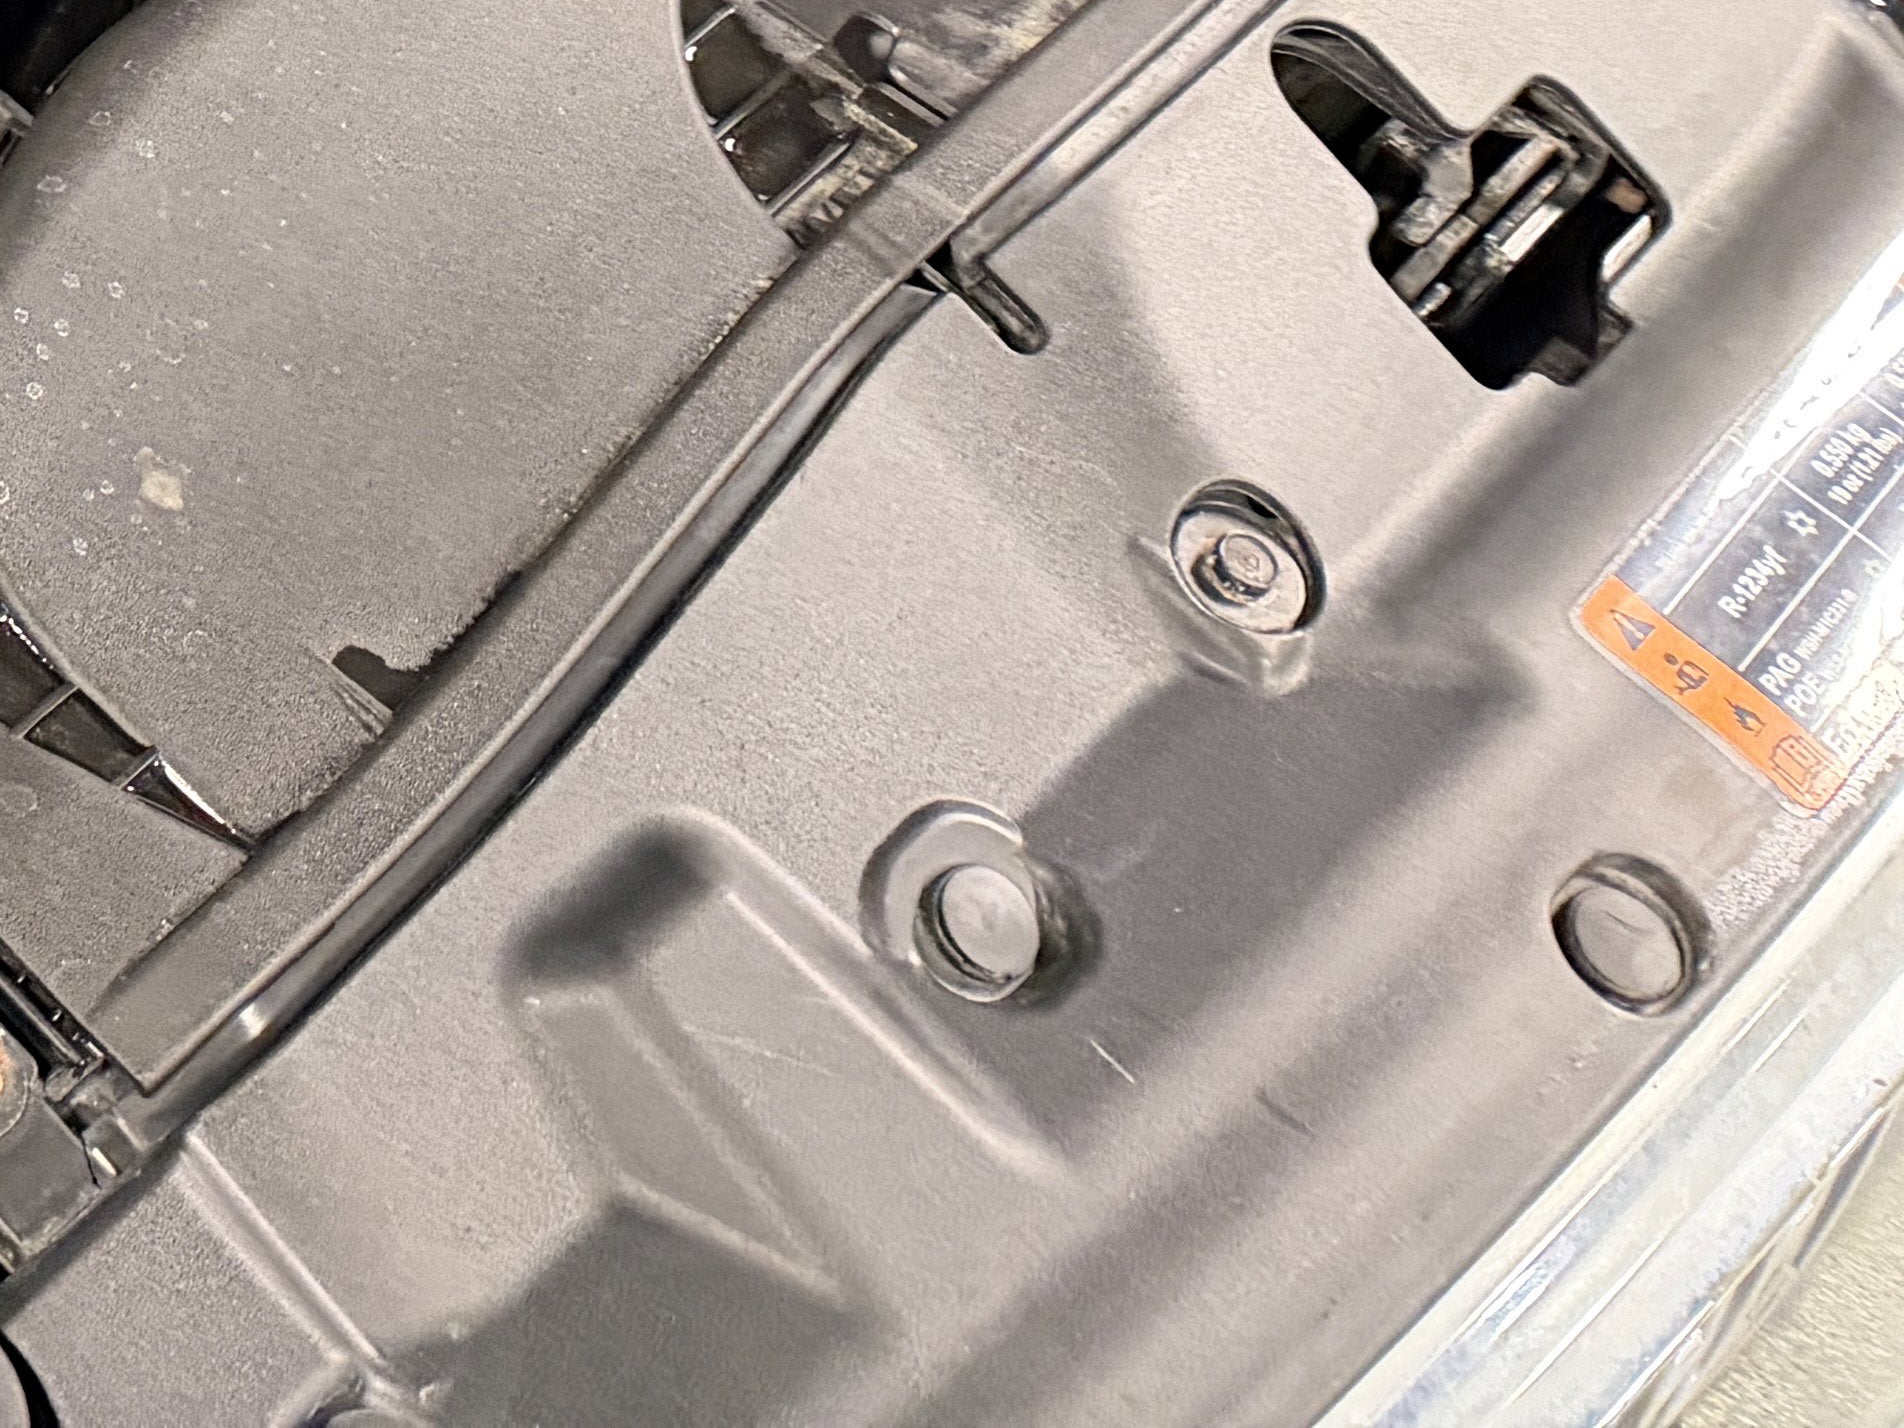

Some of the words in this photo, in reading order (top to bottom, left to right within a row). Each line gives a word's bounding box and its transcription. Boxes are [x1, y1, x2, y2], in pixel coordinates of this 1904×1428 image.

[1810, 435, 1855, 479] 0.550
[1836, 422, 1876, 447] kg
[1717, 544, 1788, 619] R-1234yf
[1758, 652, 1802, 696] PAG
[1783, 671, 1827, 718] POE
